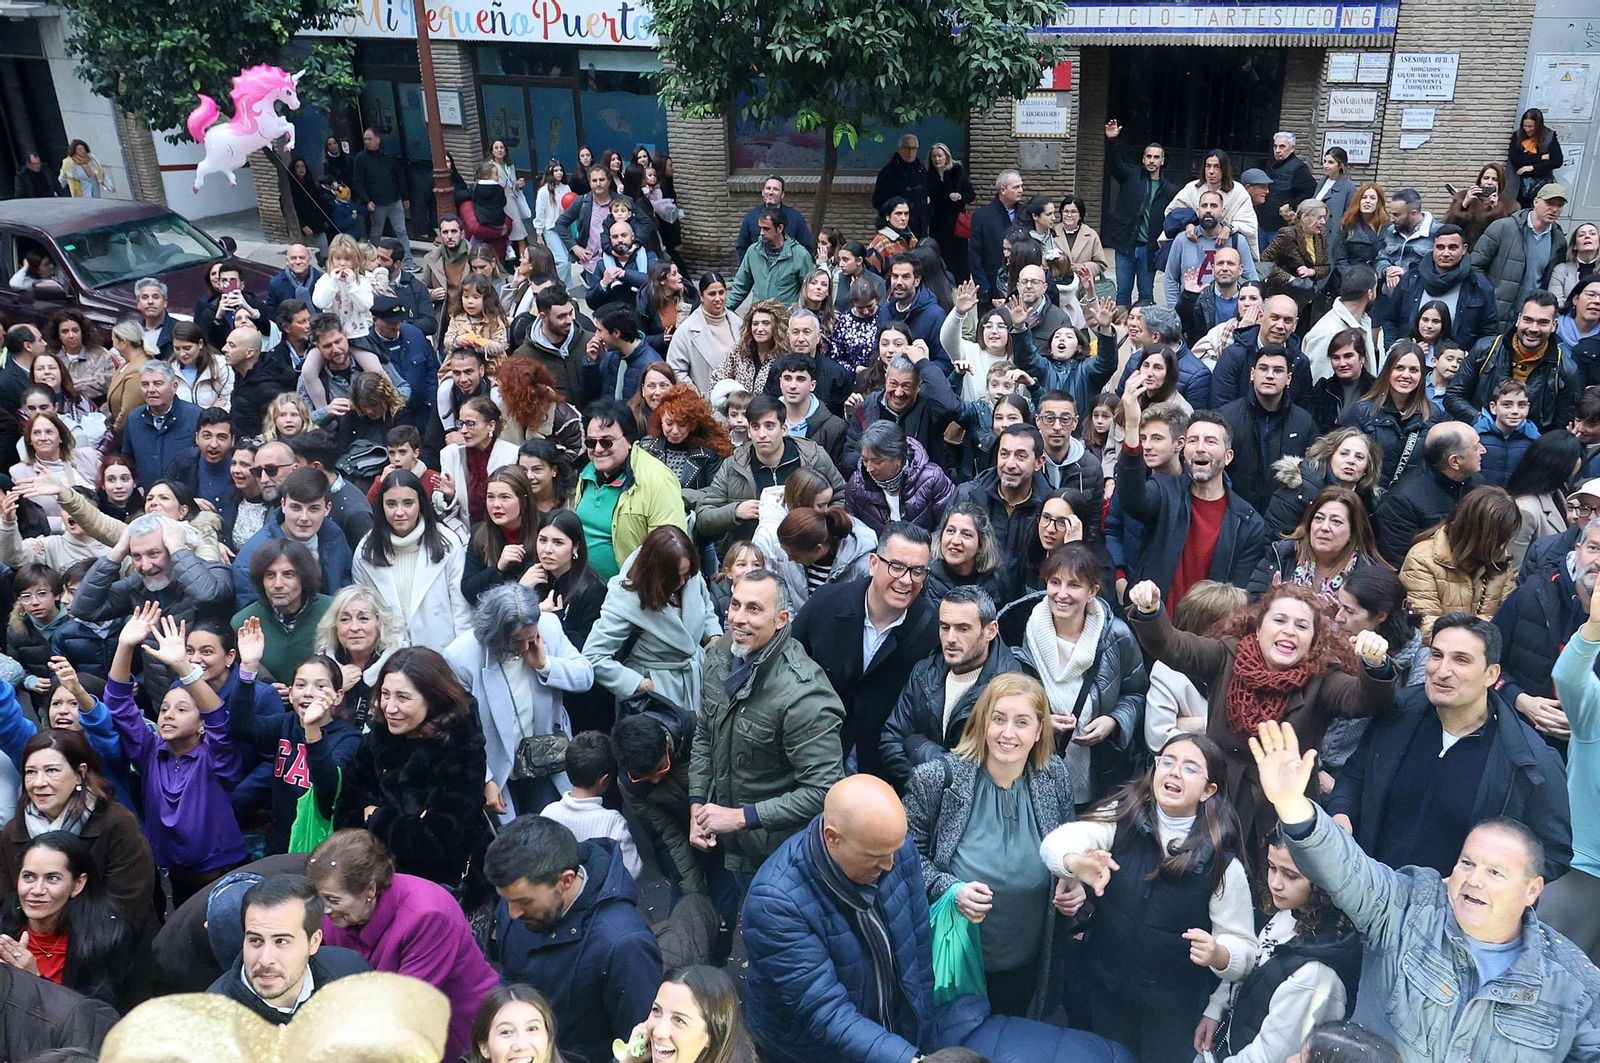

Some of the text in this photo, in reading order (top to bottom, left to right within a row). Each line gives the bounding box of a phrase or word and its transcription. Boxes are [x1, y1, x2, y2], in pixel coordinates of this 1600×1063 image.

[343, 0, 398, 34] Mi
[532, 0, 652, 43] Puerto
[1021, 110, 1061, 118] LABORATORIO
